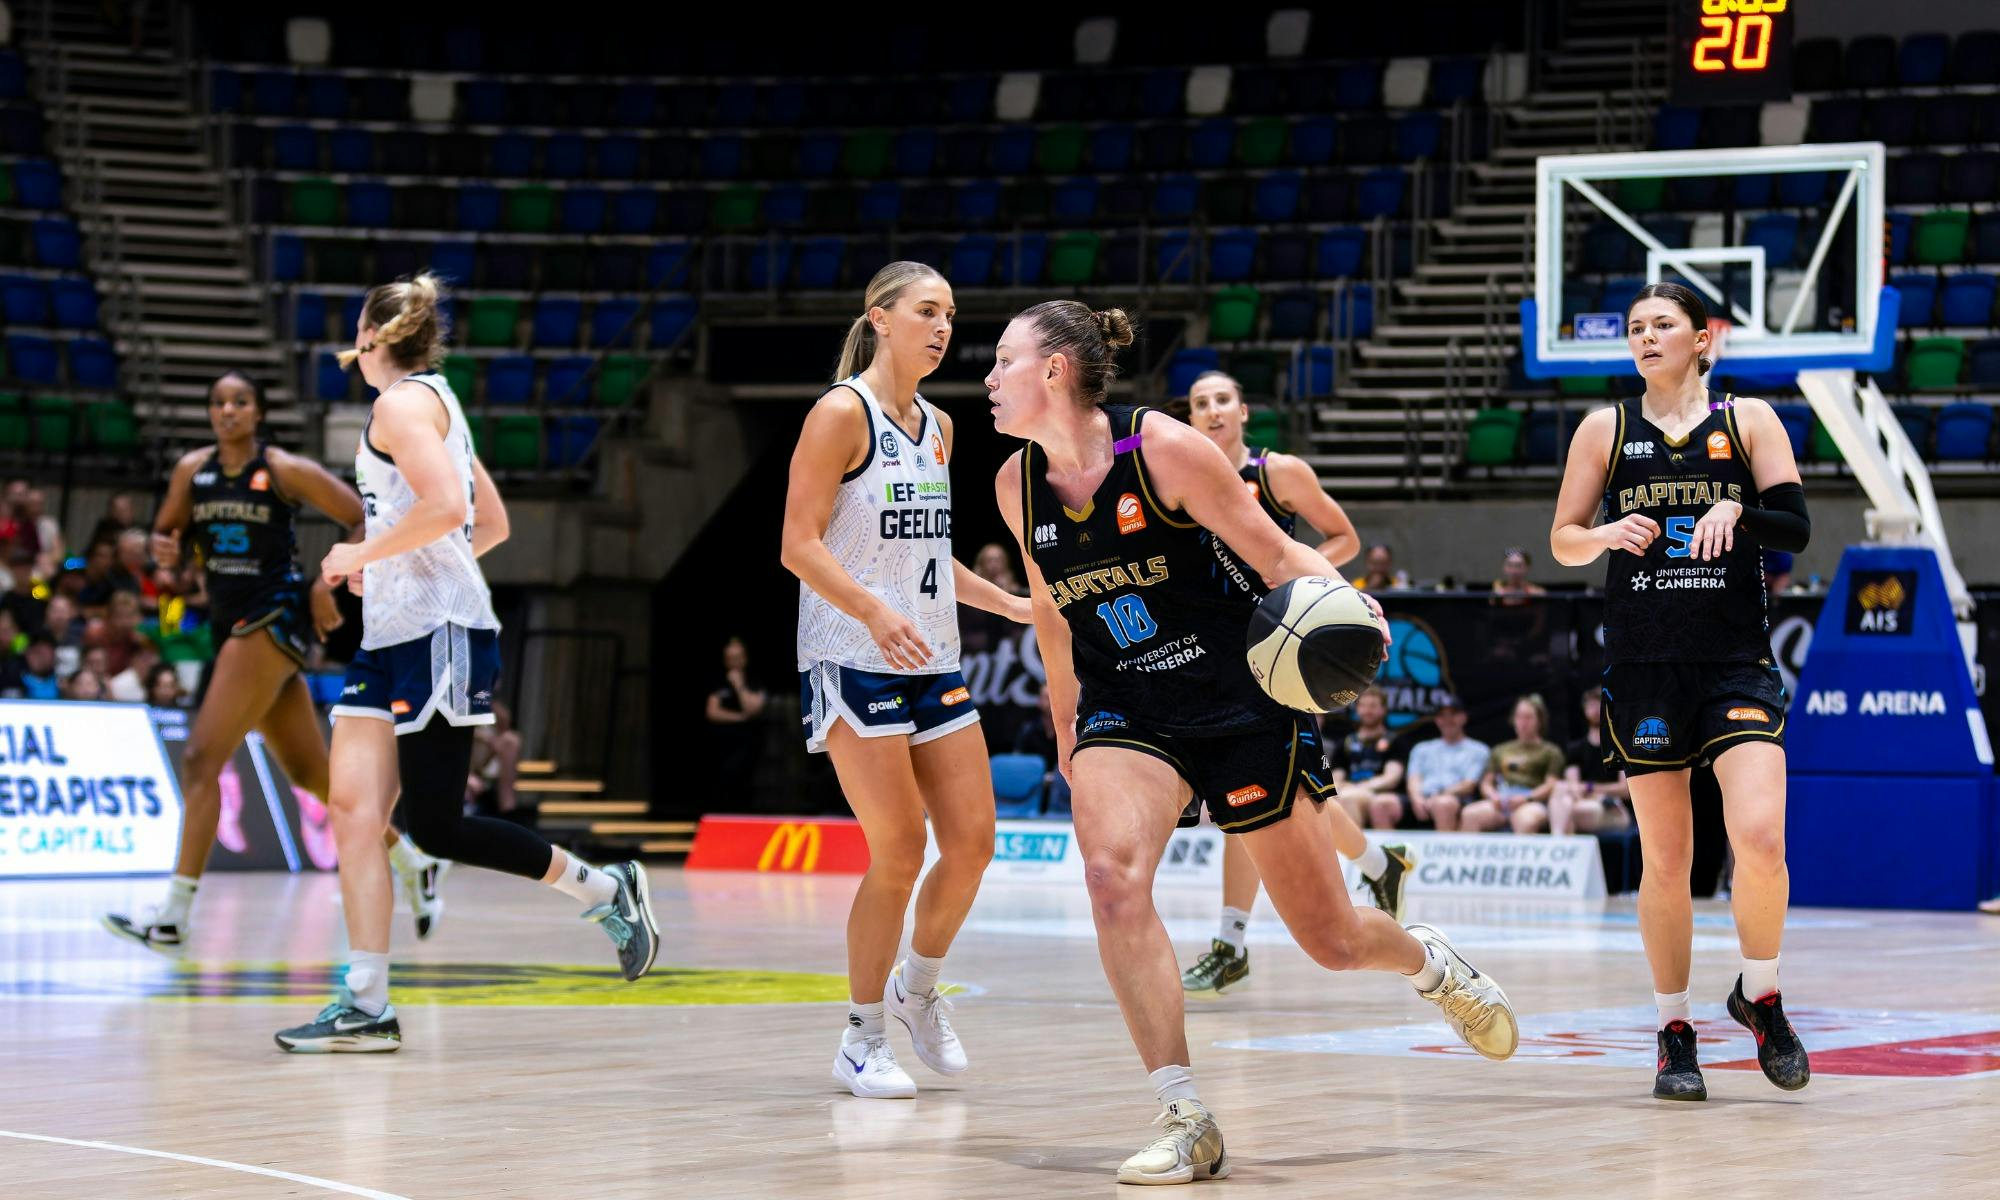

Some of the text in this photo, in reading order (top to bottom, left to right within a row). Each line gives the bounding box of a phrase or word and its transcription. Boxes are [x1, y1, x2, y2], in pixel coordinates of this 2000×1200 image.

[1693, 15, 1773, 71] 20
[886, 483, 916, 503] IEF
[1620, 481, 1742, 514] CAPITALS
[1665, 516, 1695, 559] 5
[920, 558, 938, 600] 4
[1047, 555, 1169, 610] CAPITALS
[1655, 567, 1727, 578] UNIVERSITY OF
[1655, 578, 1727, 590] CANBERRA
[1096, 592, 1159, 650] 10
[1860, 610, 1899, 633] AIS
[1182, 633, 1199, 646] OF
[867, 699, 900, 714] gawk
[1806, 689, 1947, 716] AIS ARENA
[1634, 736, 1670, 746] CAPITALS
[18, 826, 135, 856] CAPITALS
[1423, 842, 1580, 861] UNIVERSITY OF
[1418, 863, 1574, 889] CANBERRA
